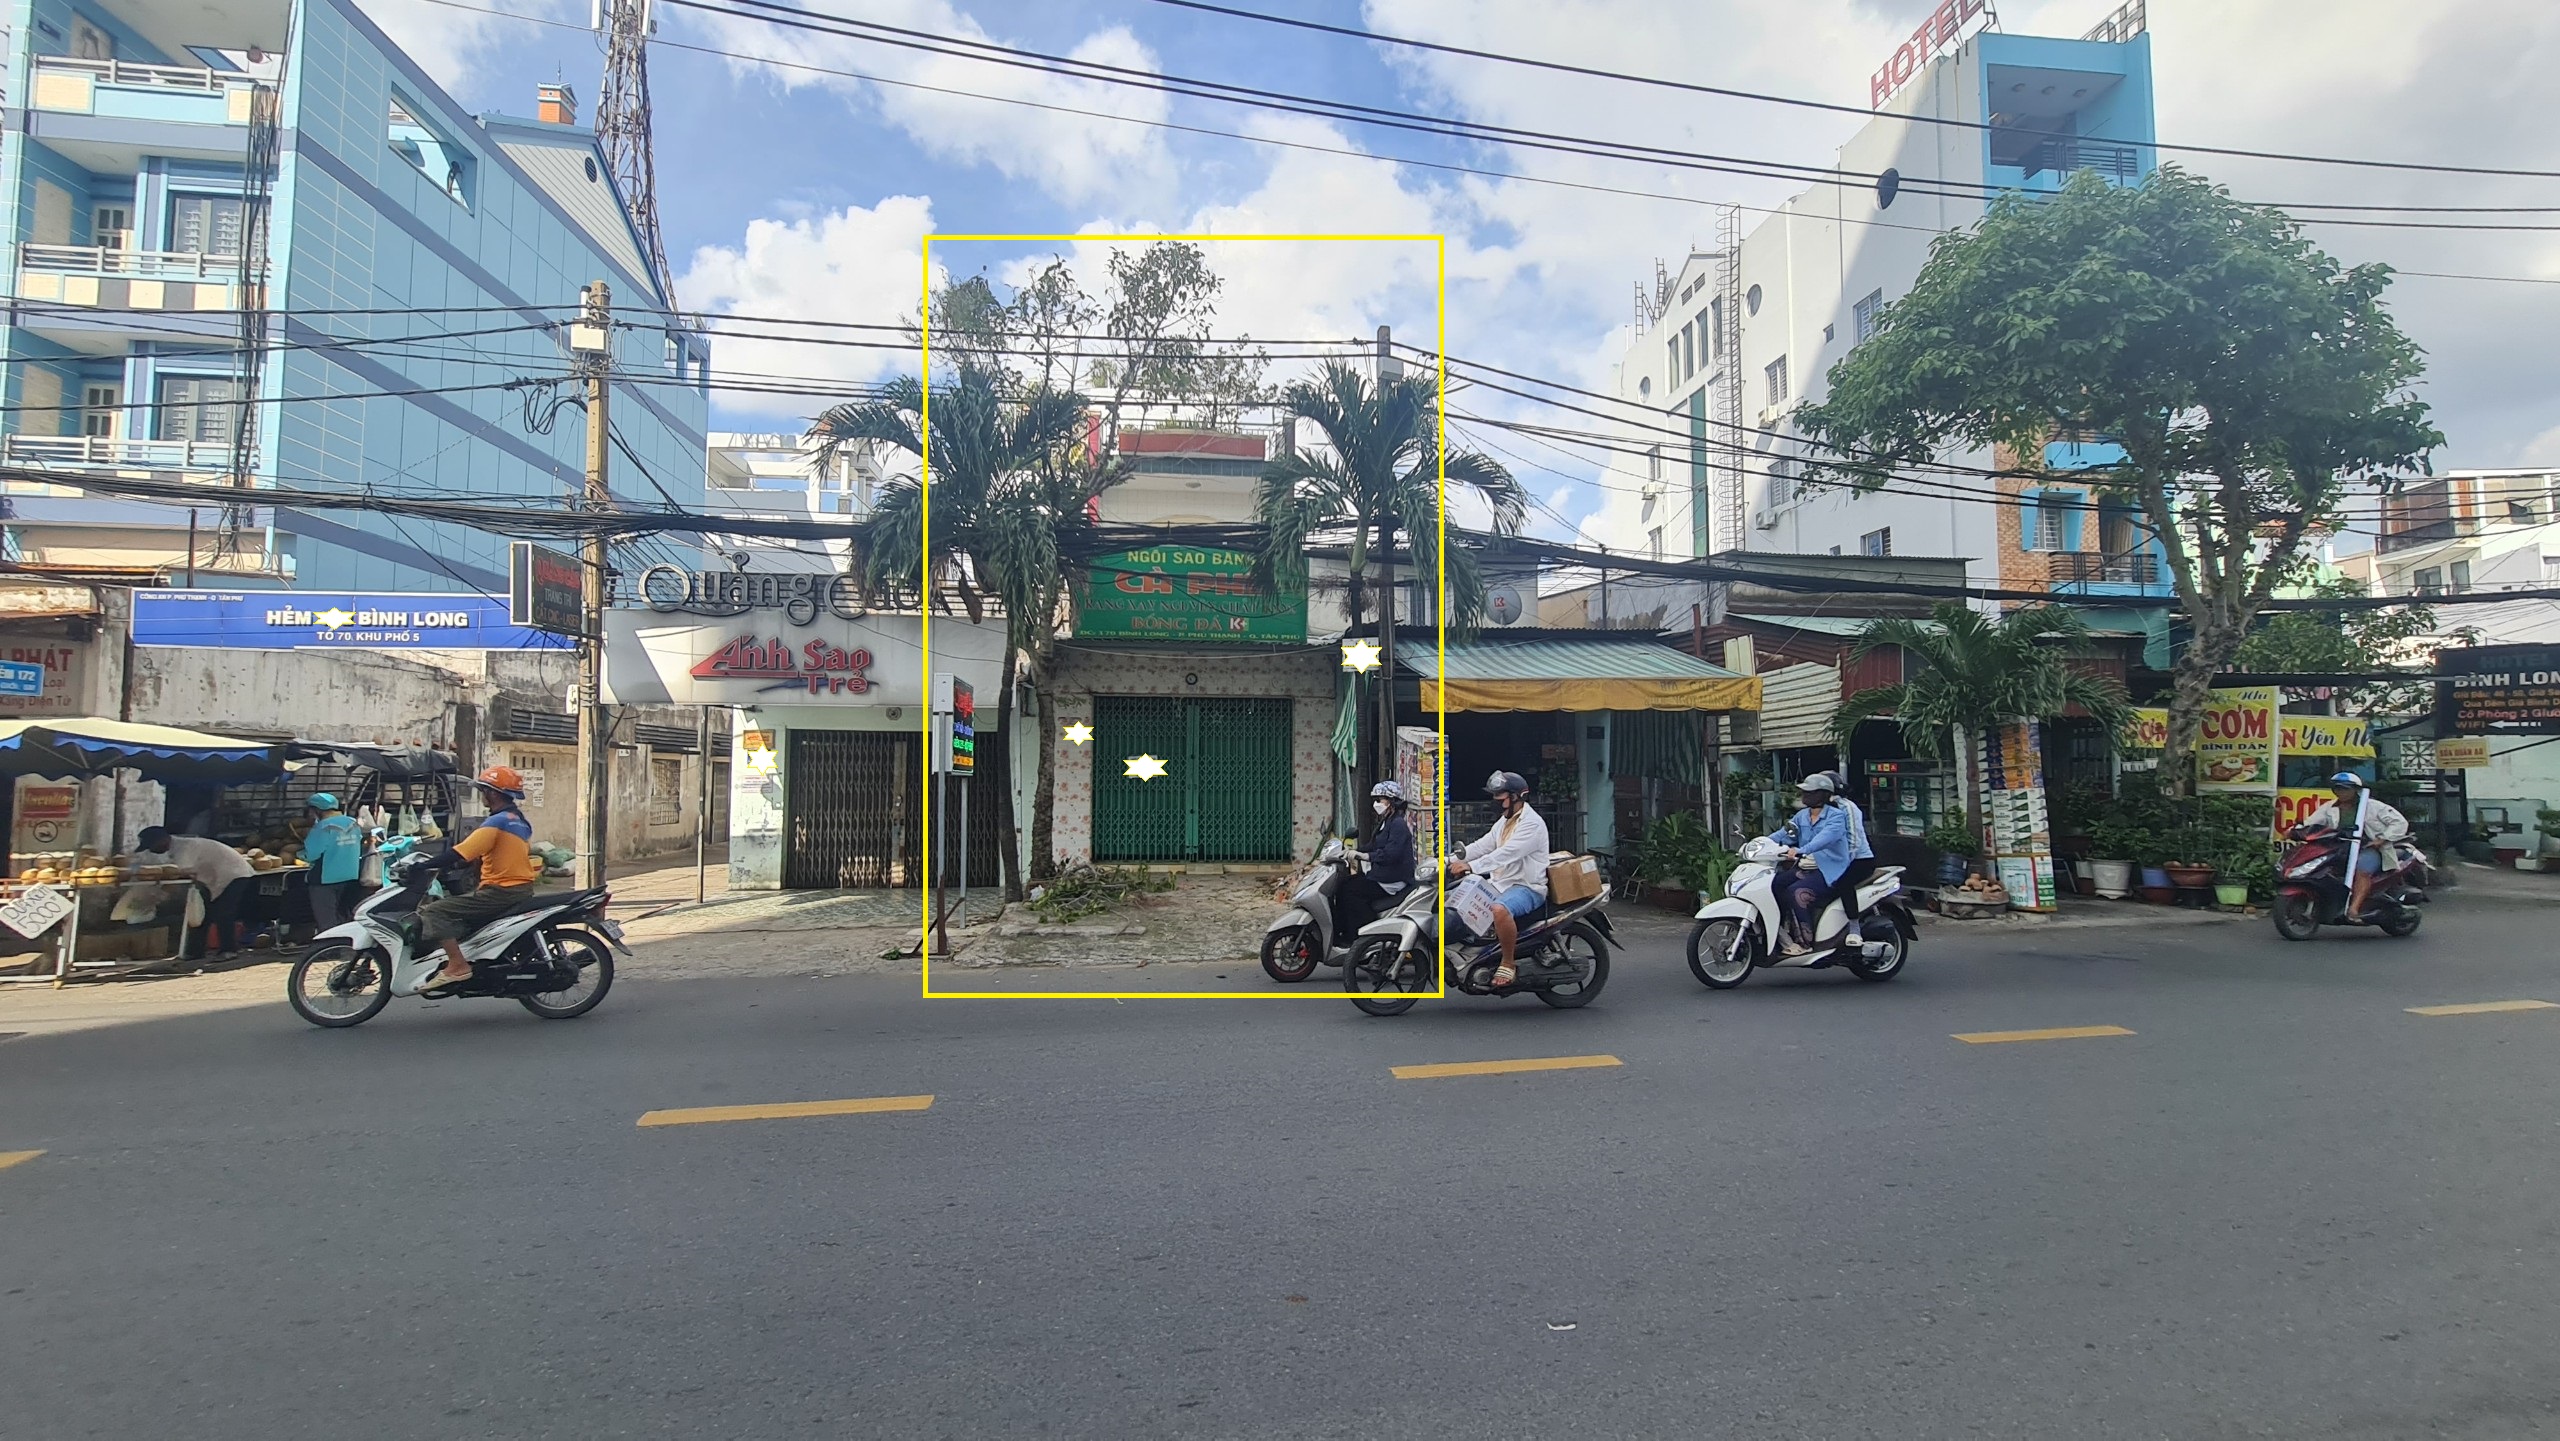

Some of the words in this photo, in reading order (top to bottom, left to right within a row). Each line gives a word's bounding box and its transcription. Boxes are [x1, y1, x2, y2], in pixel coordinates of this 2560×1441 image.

[1871, 0, 1983, 110] HOTEL
[1127, 547, 1166, 563] NGÔI
[1172, 551, 1205, 565] SAO
[638, 551, 817, 626] Quảng
[823, 571, 922, 620] Co
[1115, 566, 1173, 595] CÀ
[266, 604, 313, 626] HẺM
[358, 607, 408, 627] BÌNH
[413, 611, 469, 628] LONG
[1131, 613, 1188, 630] BÓNG
[1194, 614, 1223, 631] ĐÁ
[356, 631, 382, 642] KHU
[384, 629, 411, 642] PHỐ
[412, 631, 421, 642] 5
[11, 643, 74, 672] PHÁT
[803, 637, 872, 671] Sao
[799, 668, 869, 694] Trẻ
[2453, 671, 2511, 688] BÌNH
[2519, 670, 2560, 686] LON
[2201, 704, 2268, 739] CƠM
[2455, 720, 2486, 729] WIFI
[2520, 709, 2529, 718] 2
[2301, 725, 2336, 750] Yến
